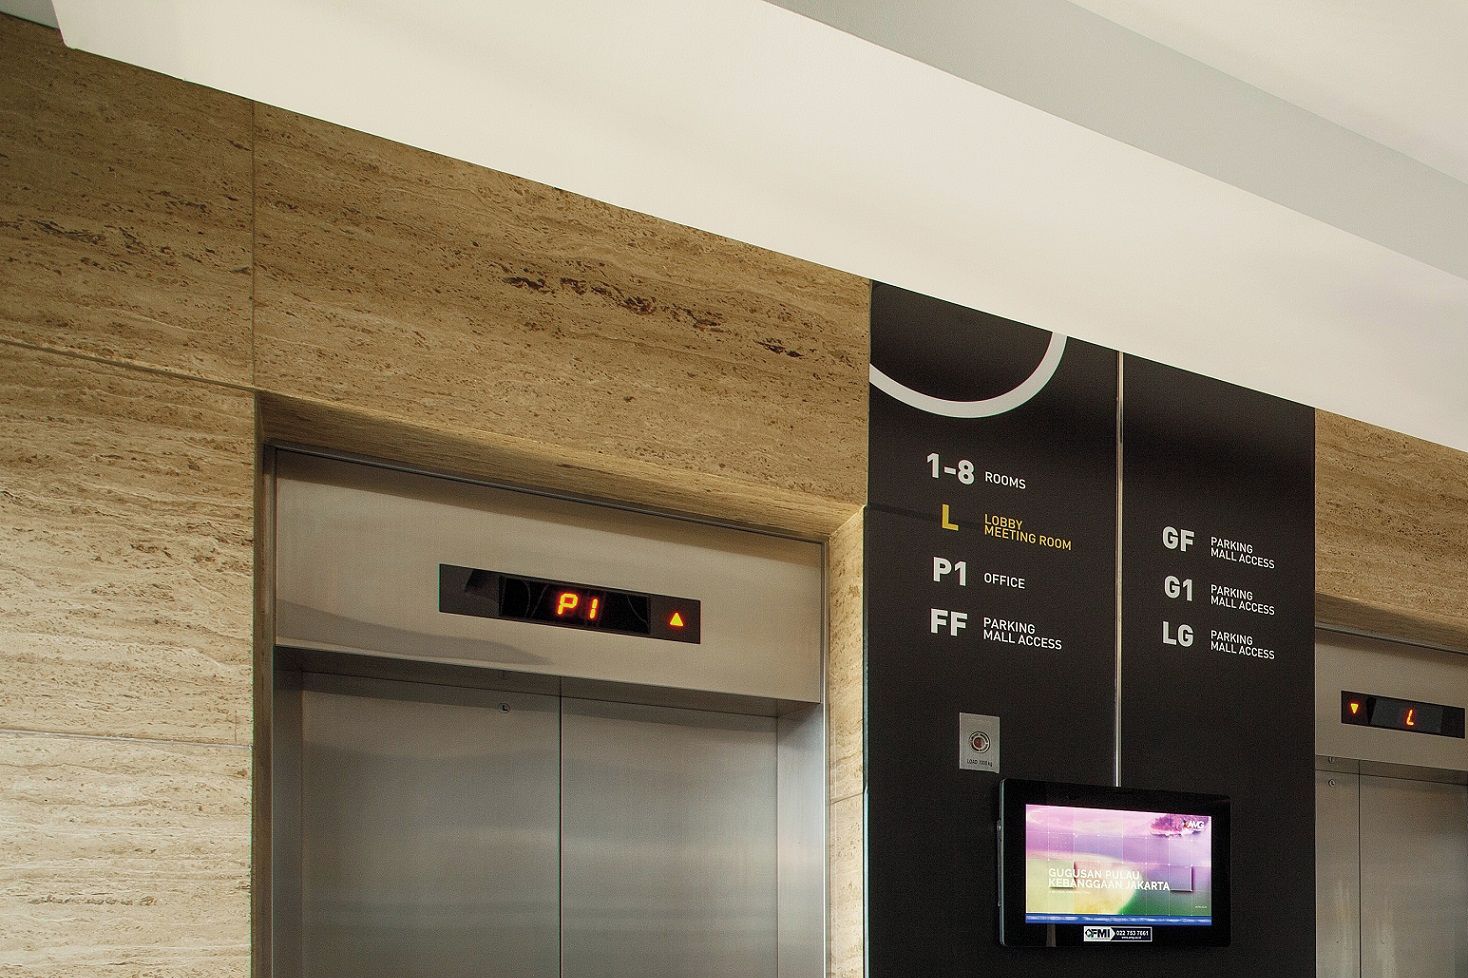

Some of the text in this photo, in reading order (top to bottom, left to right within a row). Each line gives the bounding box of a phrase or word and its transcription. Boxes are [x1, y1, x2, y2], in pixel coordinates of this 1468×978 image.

[927, 453, 1026, 489] 1-8 ROOMS
[942, 504, 959, 531] L
[984, 514, 1023, 530] LOBBY
[984, 525, 1072, 551] MEETING ROOM
[1162, 526, 1195, 552] GF
[1210, 536, 1253, 554] PARKING
[1210, 548, 1275, 569] MALL ACCESS
[933, 556, 1025, 589] P1 OFFICE
[1164, 575, 1193, 601] G1
[1210, 584, 1253, 601] PARKING
[556, 592, 599, 620] P1
[1210, 595, 1275, 616] MALL ACCESS
[930, 608, 968, 637] FF
[983, 617, 1036, 635] PARKING
[983, 630, 1062, 650] MALL ACCESS
[1162, 621, 1194, 647] LG
[1210, 629, 1253, 646] PARKING
[1210, 641, 1275, 660] MALL ACCESS
[1406, 709, 1415, 726] L
[1048, 868, 1140, 880] GUGUSAN PULAU
[1048, 878, 1170, 891] KEBANGGAAN JAKARTA
